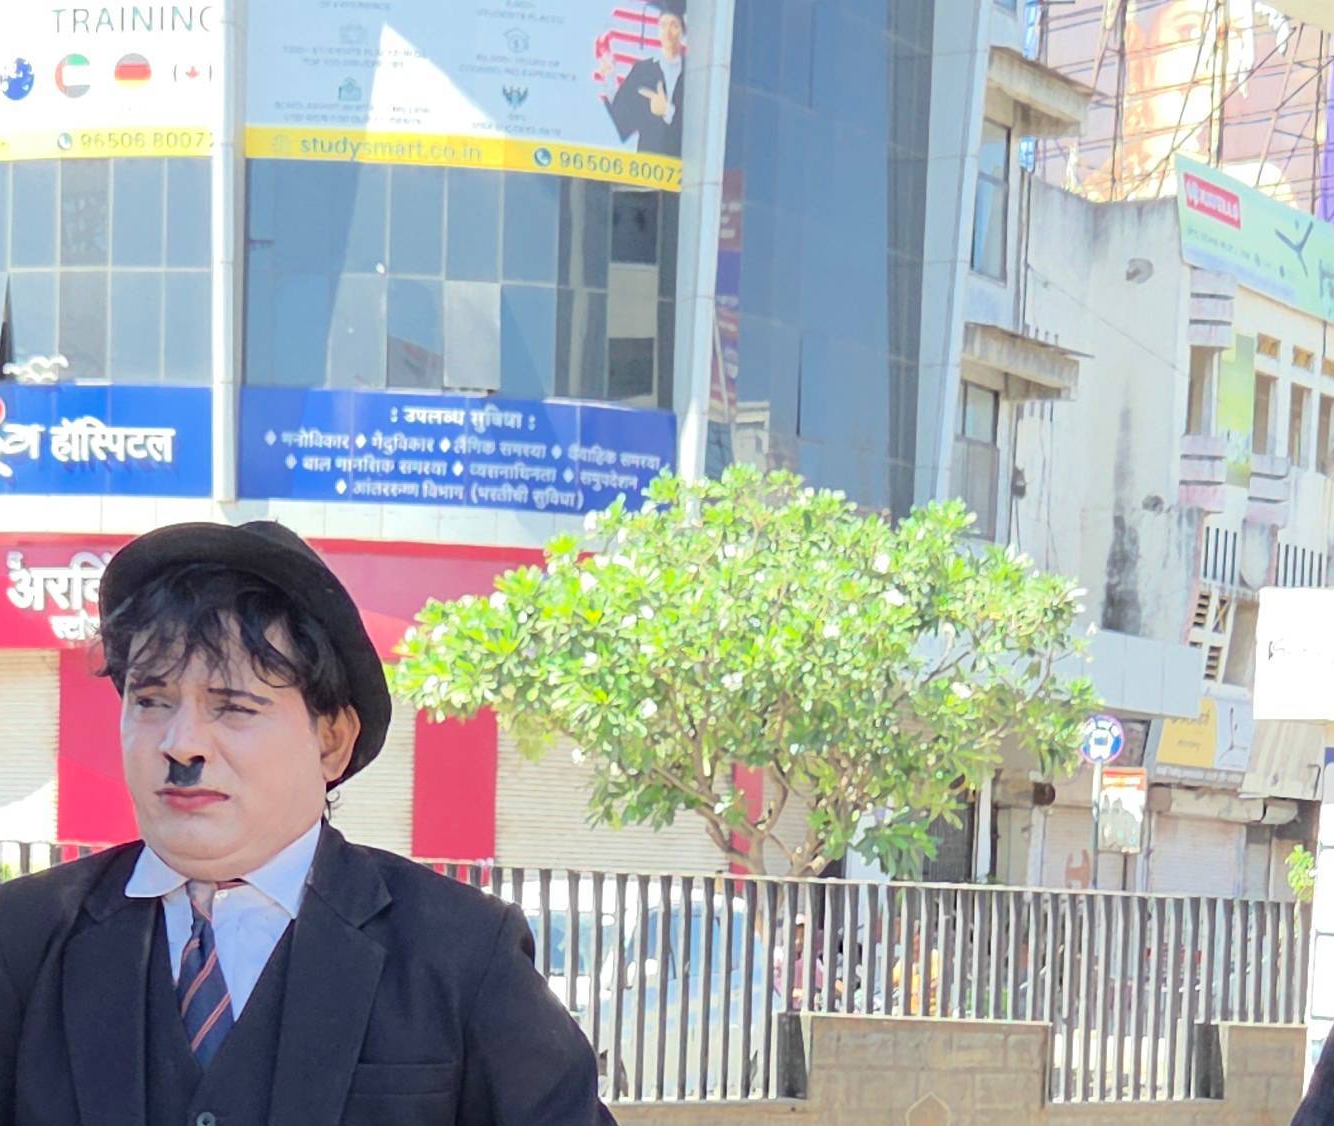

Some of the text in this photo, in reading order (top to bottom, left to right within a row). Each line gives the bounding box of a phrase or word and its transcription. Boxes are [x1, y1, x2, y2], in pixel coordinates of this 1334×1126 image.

[300, 136, 483, 162] studysmart.co.in
[559, 151, 624, 176] 96506
[403, 406, 466, 426] उपलब्ध
[470, 403, 524, 433] सुविधा
[49, 415, 177, 464] हॉस्पिटल
